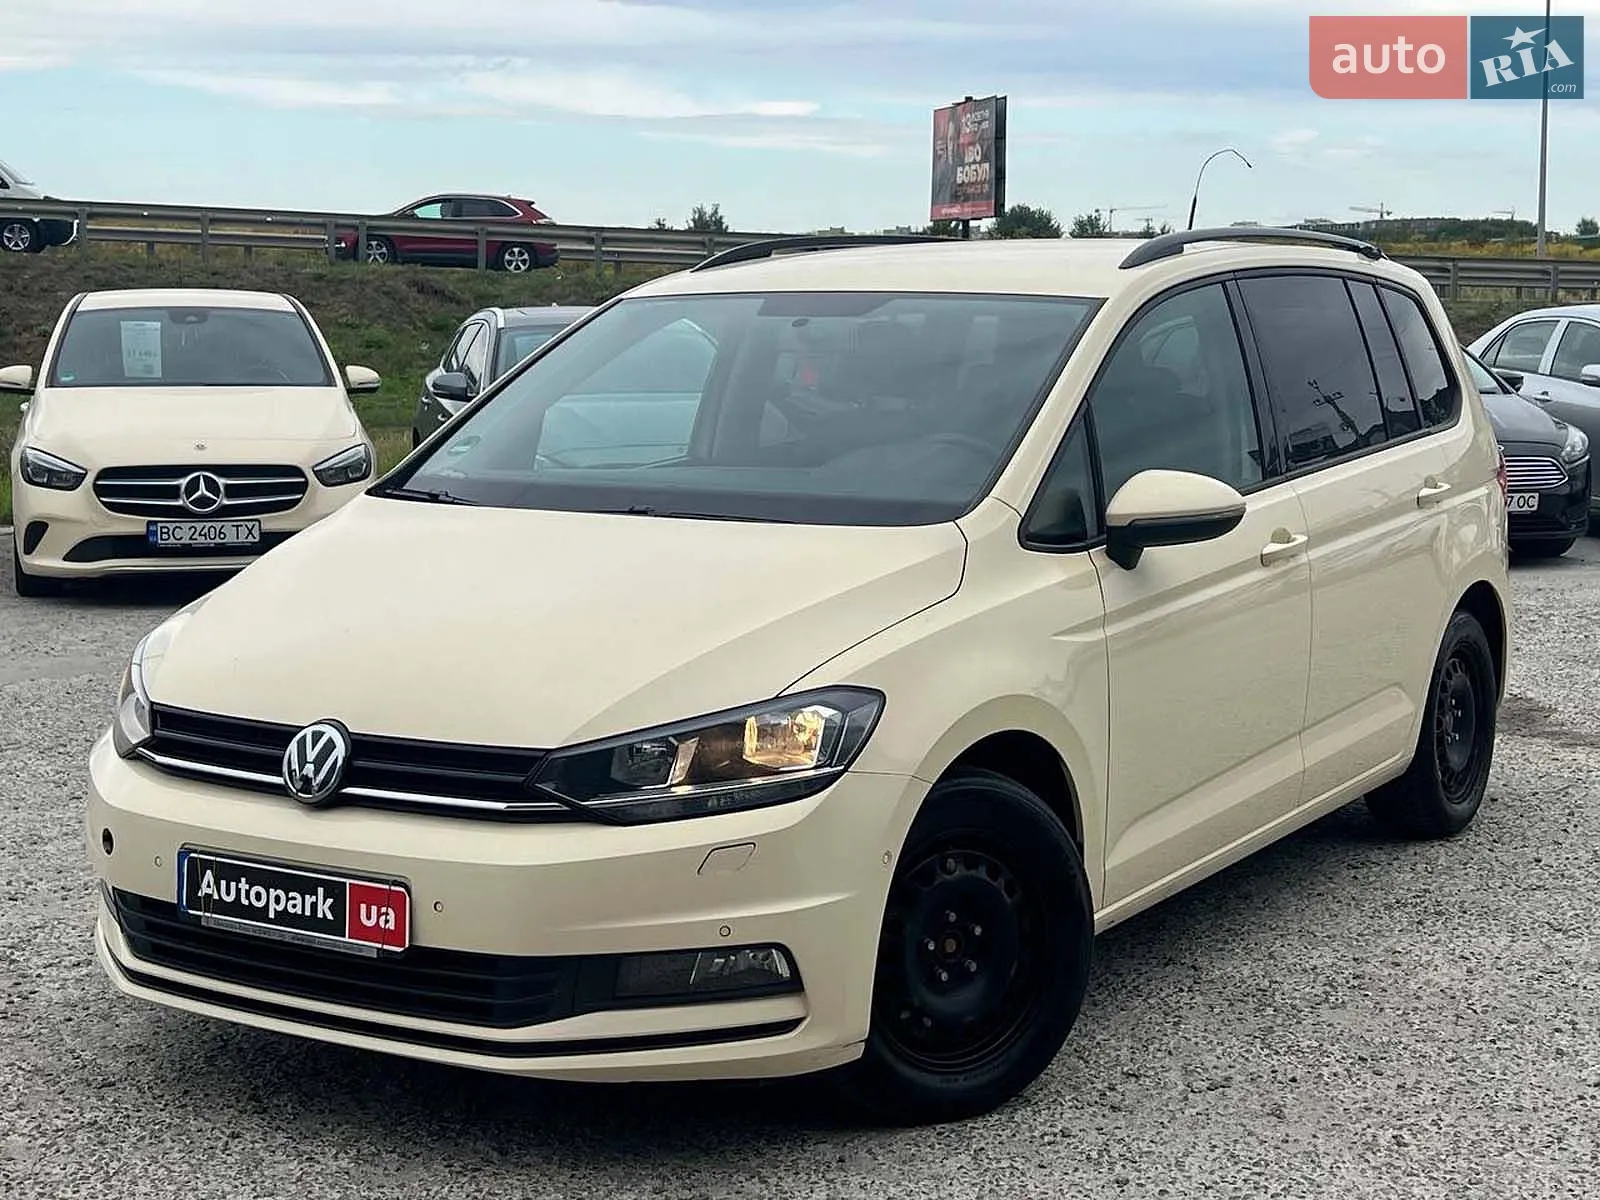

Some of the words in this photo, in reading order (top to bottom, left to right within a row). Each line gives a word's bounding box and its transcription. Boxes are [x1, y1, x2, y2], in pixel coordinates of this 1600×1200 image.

[159, 525, 183, 541] BC
[188, 525, 227, 541] 2406
[231, 524, 257, 540] TX
[197, 869, 335, 921] Autopark
[359, 902, 396, 931] ua
